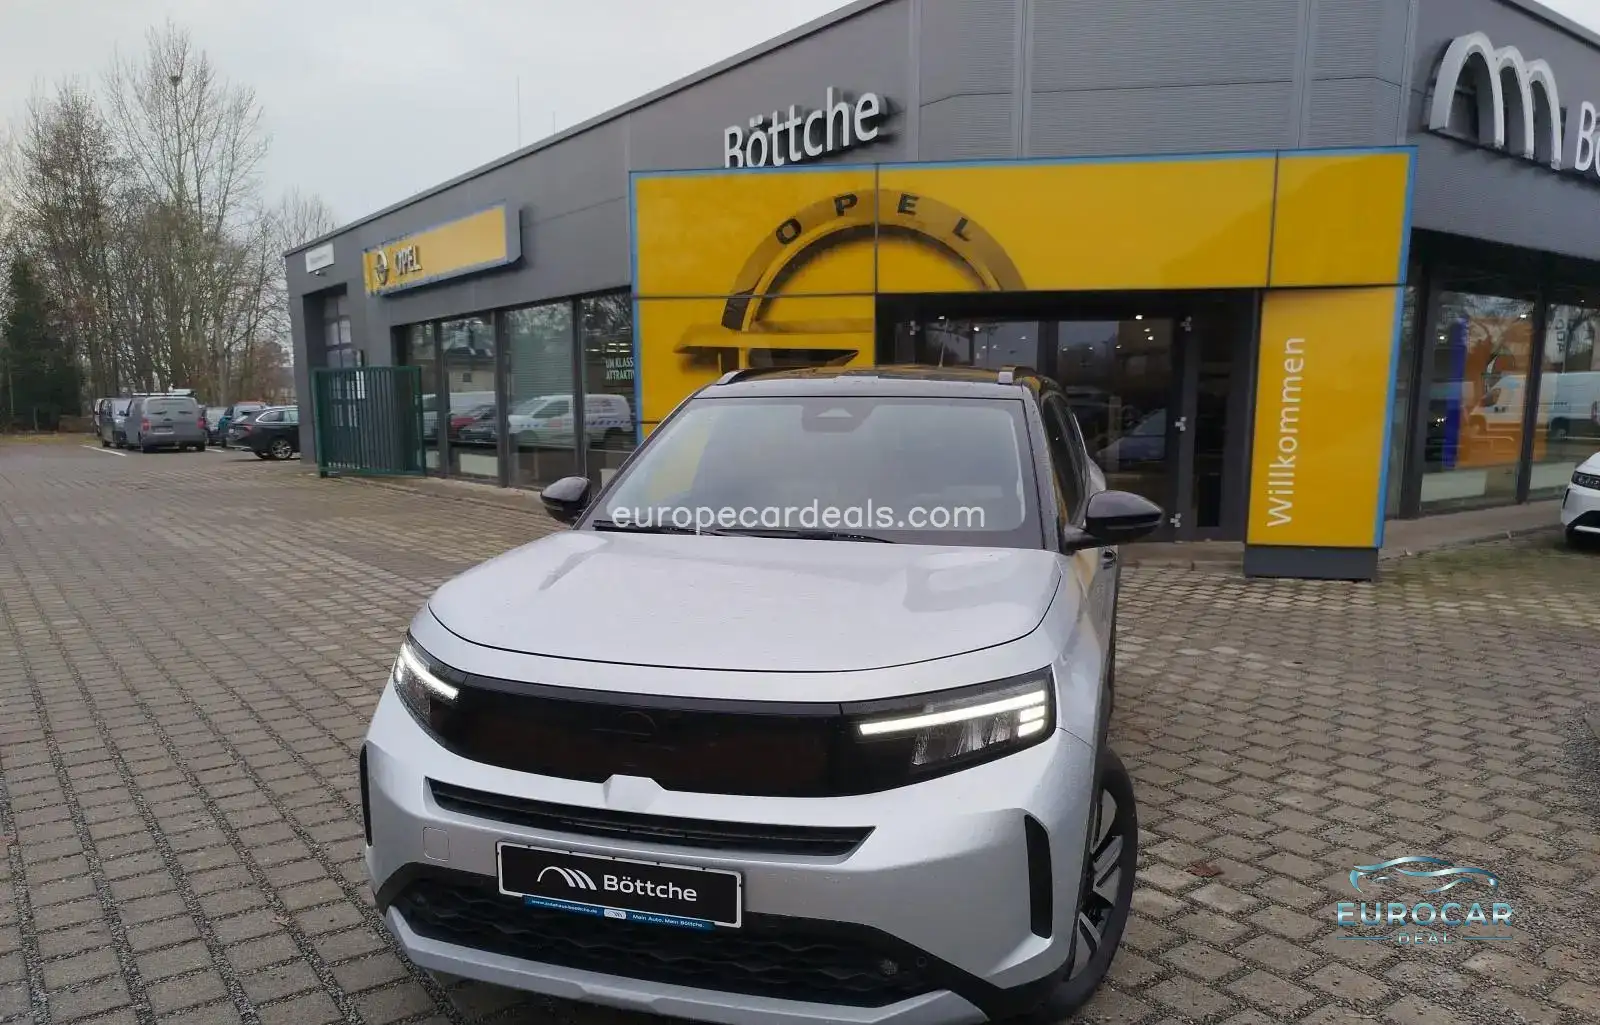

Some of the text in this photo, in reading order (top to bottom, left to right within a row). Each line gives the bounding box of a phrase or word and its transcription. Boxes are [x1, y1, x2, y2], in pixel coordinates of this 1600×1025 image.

[724, 86, 880, 168] Böttche
[777, 193, 971, 243] OPEL
[395, 244, 422, 276] OPEL
[1267, 337, 1306, 527] Willkommen
[603, 875, 697, 902] Böttche
[680, 920, 705, 928] Böttche.
